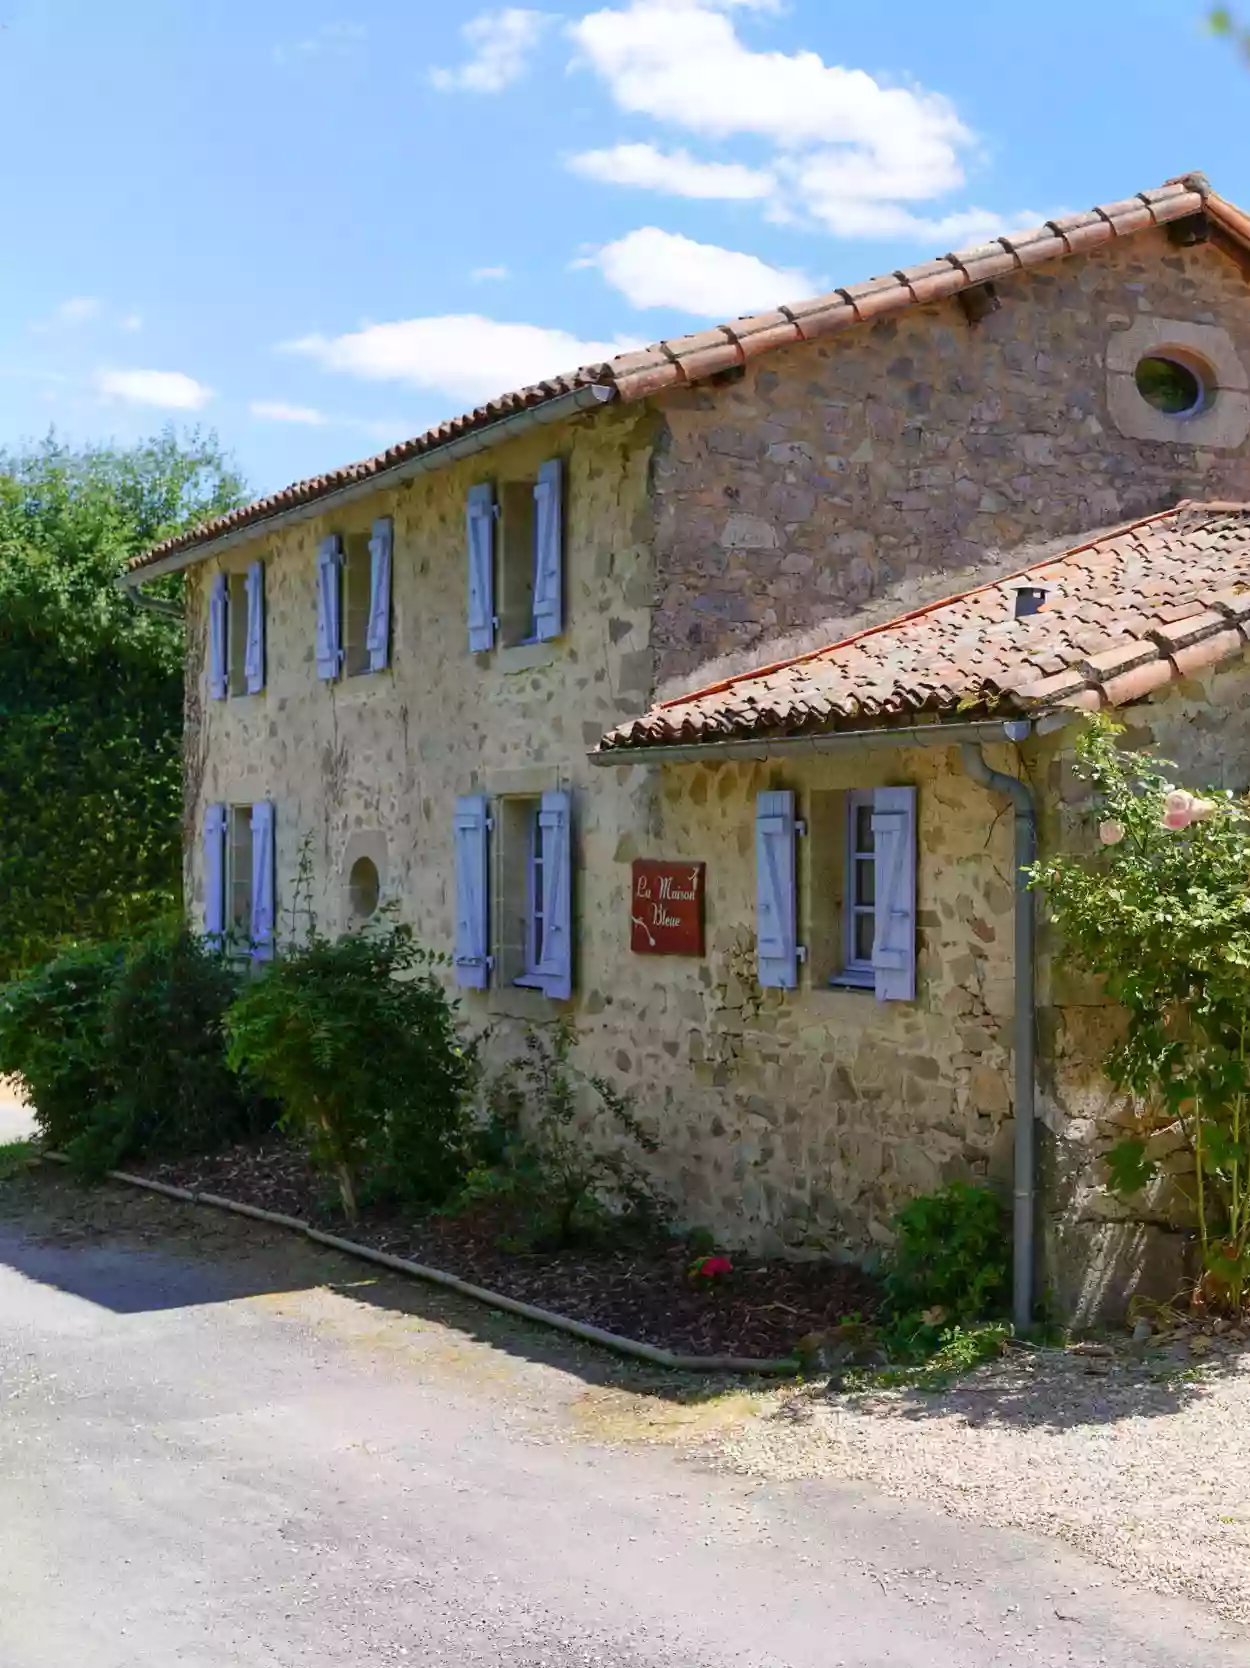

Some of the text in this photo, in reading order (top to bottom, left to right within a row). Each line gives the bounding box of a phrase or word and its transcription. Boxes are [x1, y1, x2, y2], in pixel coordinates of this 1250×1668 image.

[637, 876, 695, 900] La Maison
[652, 902, 681, 927] Bleue
